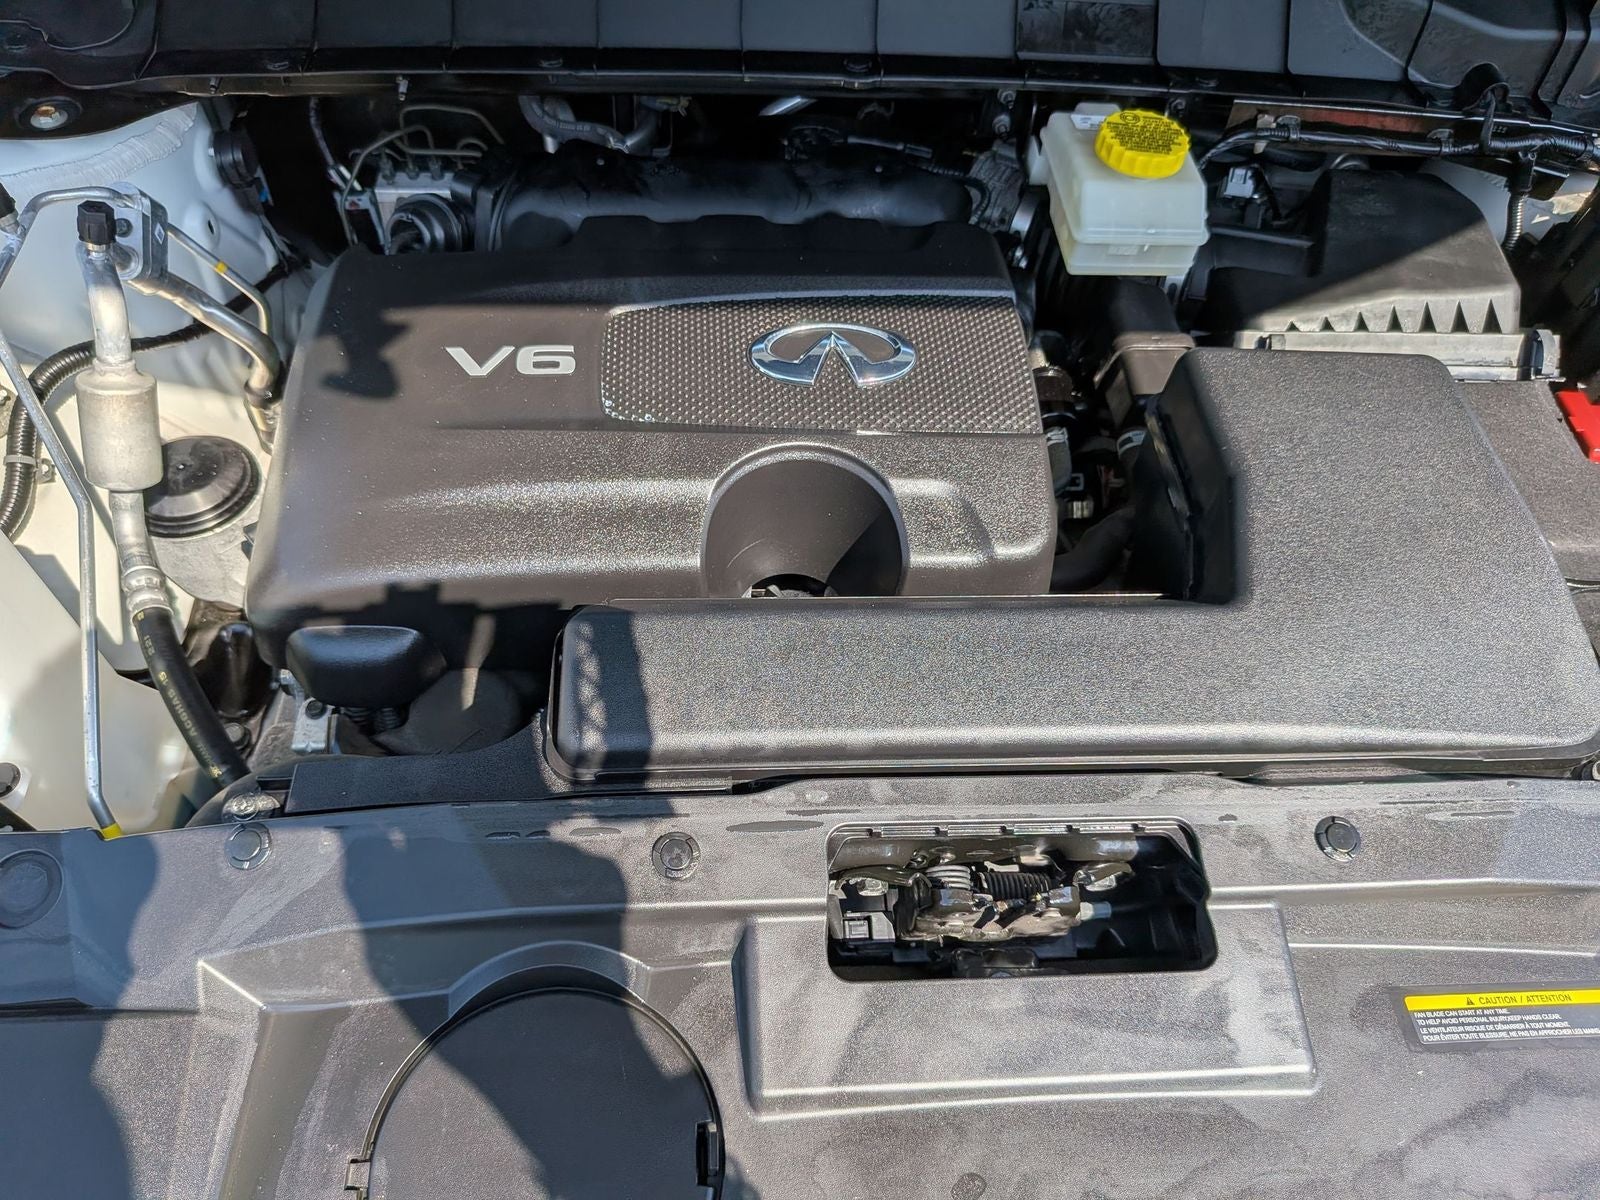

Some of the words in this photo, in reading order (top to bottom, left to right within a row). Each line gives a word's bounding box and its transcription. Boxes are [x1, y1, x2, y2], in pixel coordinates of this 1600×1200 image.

[445, 345, 576, 376] V6
[1478, 996, 1518, 1005] CAUTION
[1526, 994, 1572, 1003] ATTENTION
[1428, 1026, 1464, 1034] VENTILATEUR
